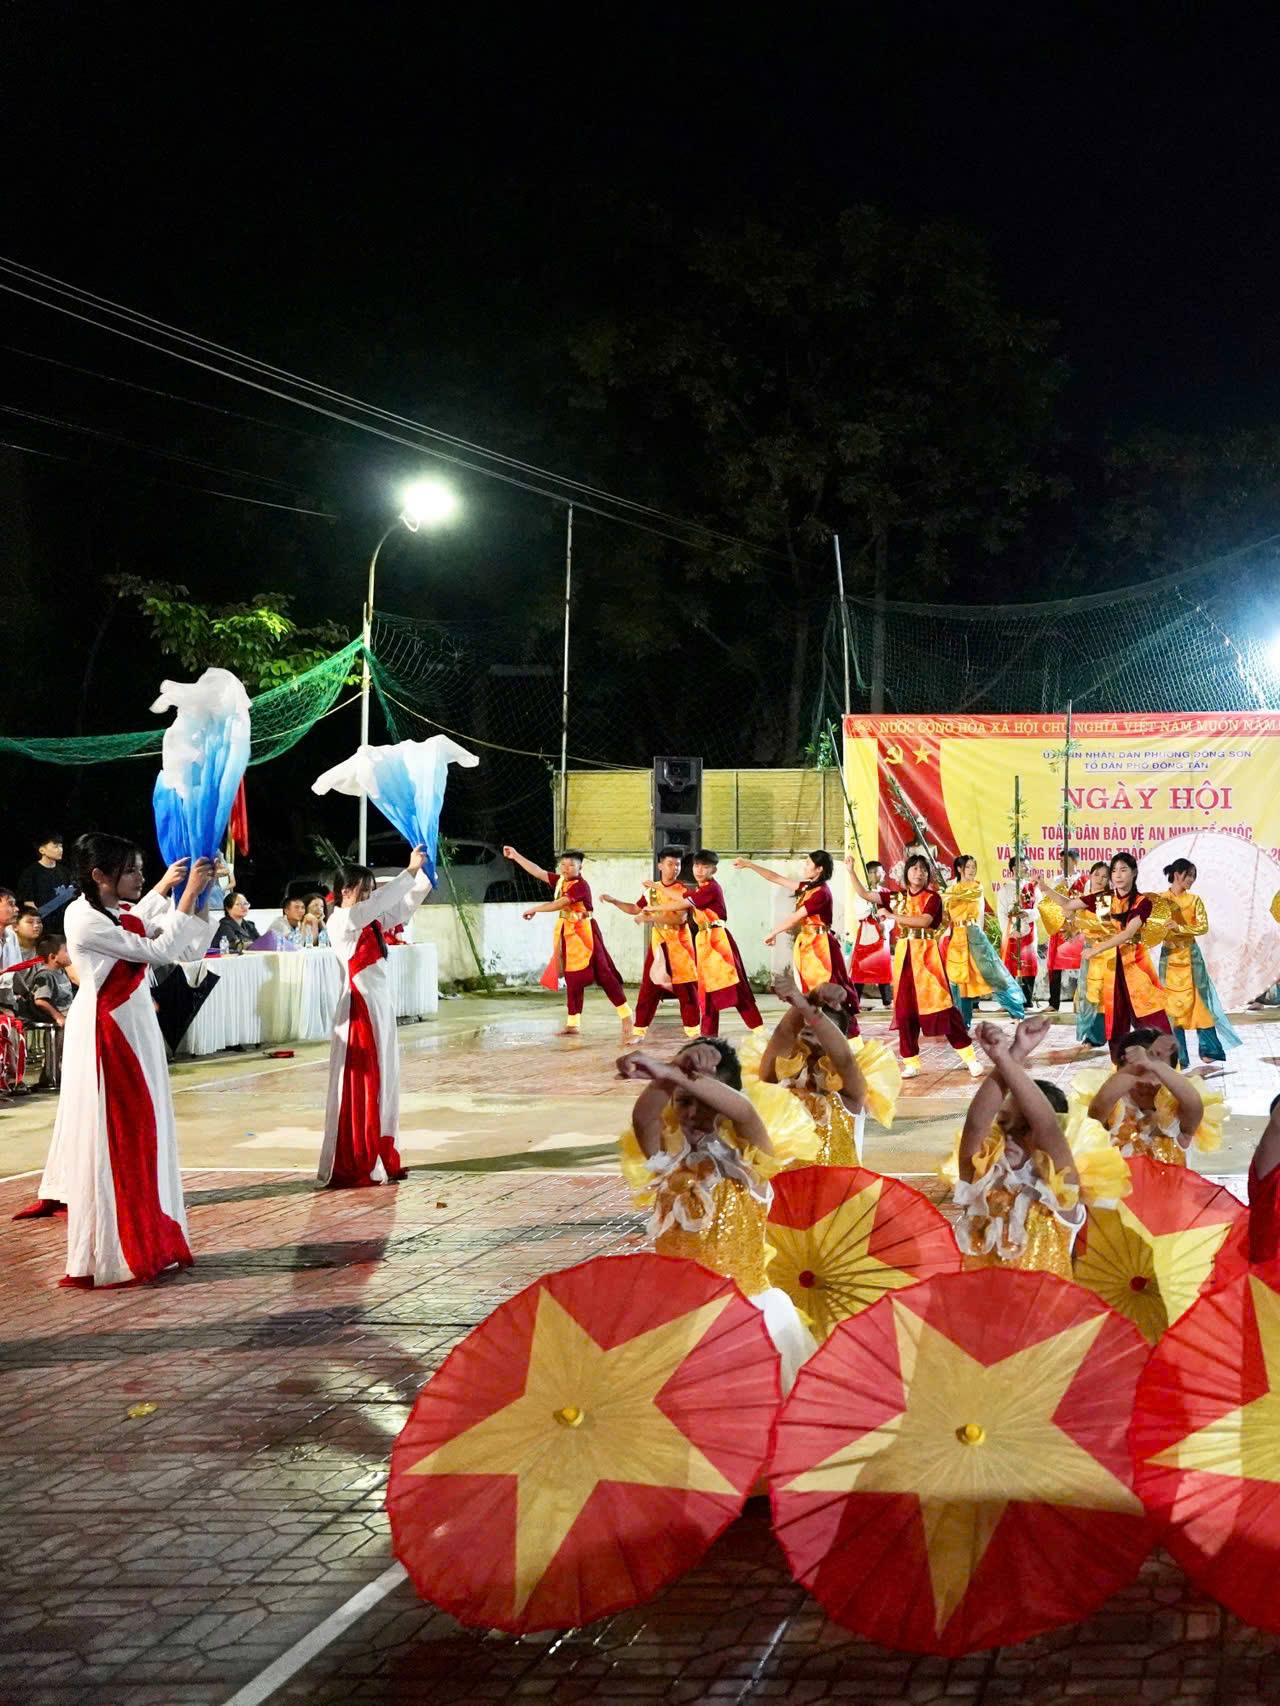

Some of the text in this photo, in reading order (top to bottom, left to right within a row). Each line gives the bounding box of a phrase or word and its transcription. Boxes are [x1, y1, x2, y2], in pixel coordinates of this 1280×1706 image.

[918, 718, 953, 736] CỘNG
[1015, 718, 1038, 736] HỘI
[1075, 718, 1119, 733] NGHĨA
[1124, 717, 1158, 735] VIỆT
[1160, 719, 1192, 733] NAM
[1197, 716, 1240, 732] MUÔN
[1061, 779, 1232, 815] NGÀY HỘI
[1076, 824, 1100, 841] DÂN
[1104, 823, 1127, 841] BẢO
[1131, 824, 1145, 844] VỆ
[1149, 826, 1165, 841] AN
[1077, 847, 1113, 862] HONG
